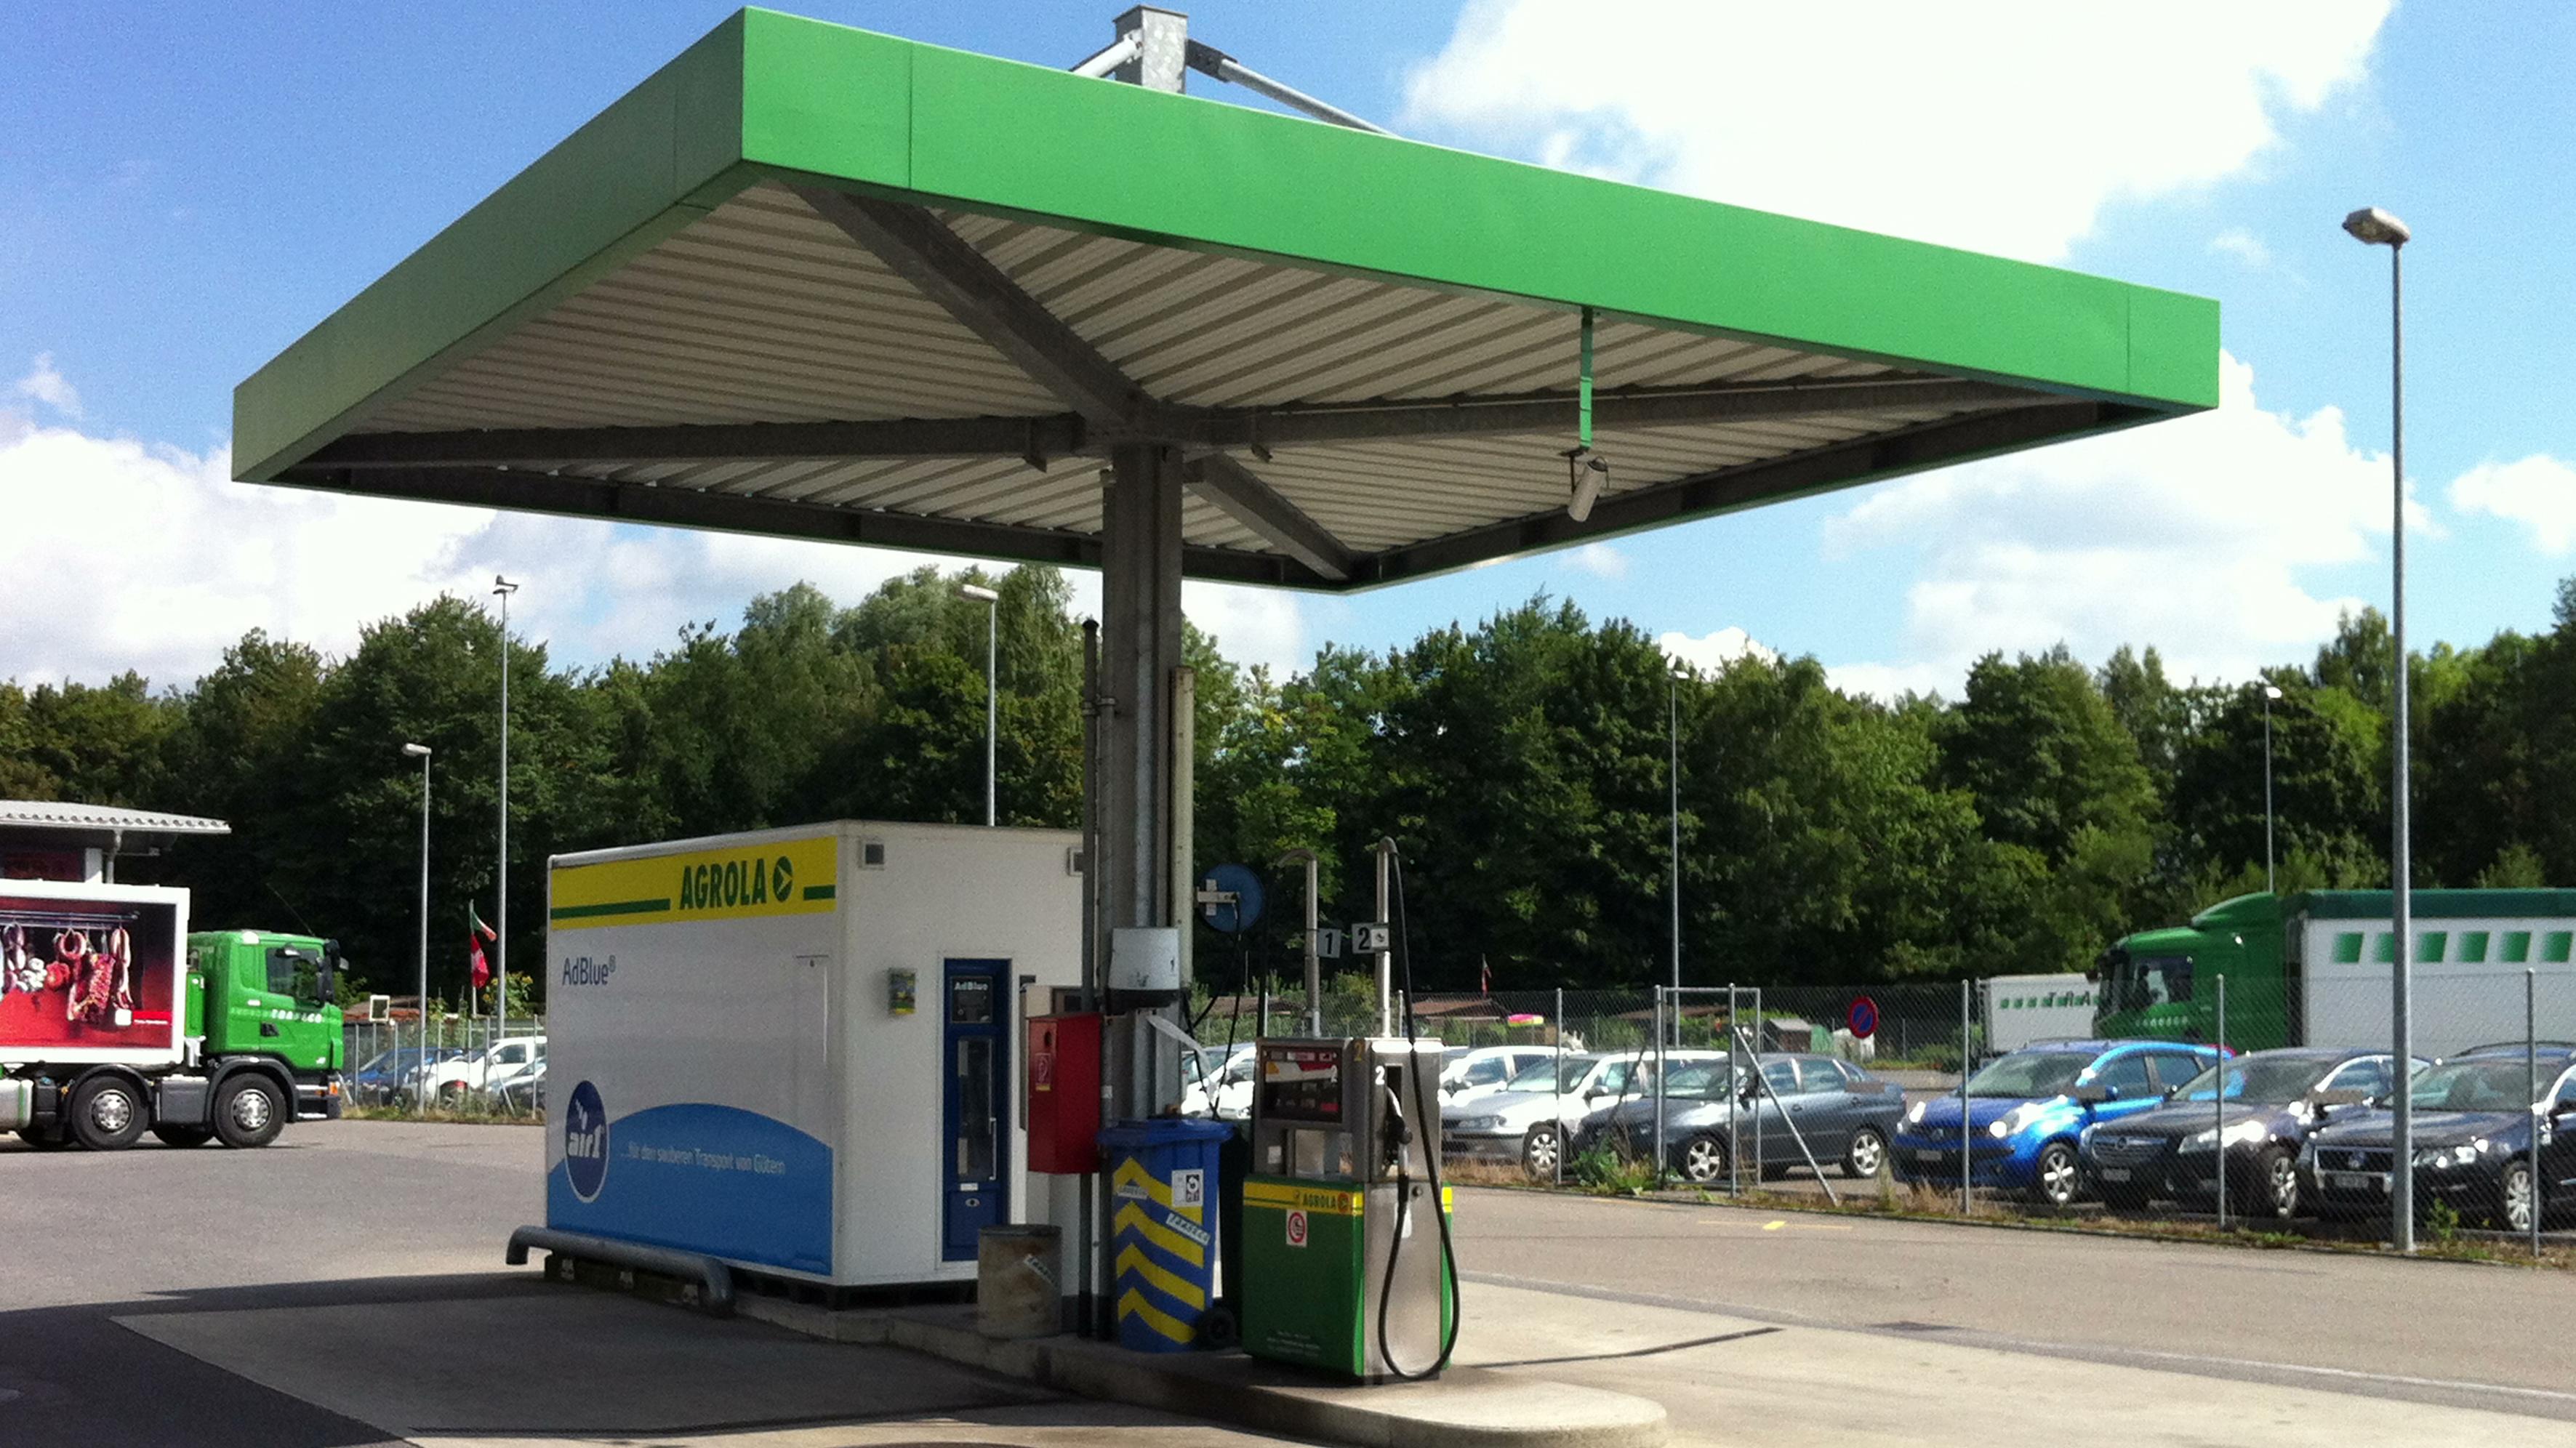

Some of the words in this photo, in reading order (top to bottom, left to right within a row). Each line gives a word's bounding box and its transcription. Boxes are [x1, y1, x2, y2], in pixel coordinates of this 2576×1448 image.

[680, 858, 767, 909] AGROLA
[1325, 932, 1333, 954] 1
[1358, 927, 1370, 950] 2
[954, 981, 988, 991] AdBlue
[1375, 1065, 1385, 1085] 2
[1302, 1192, 1336, 1210] AGROLA
